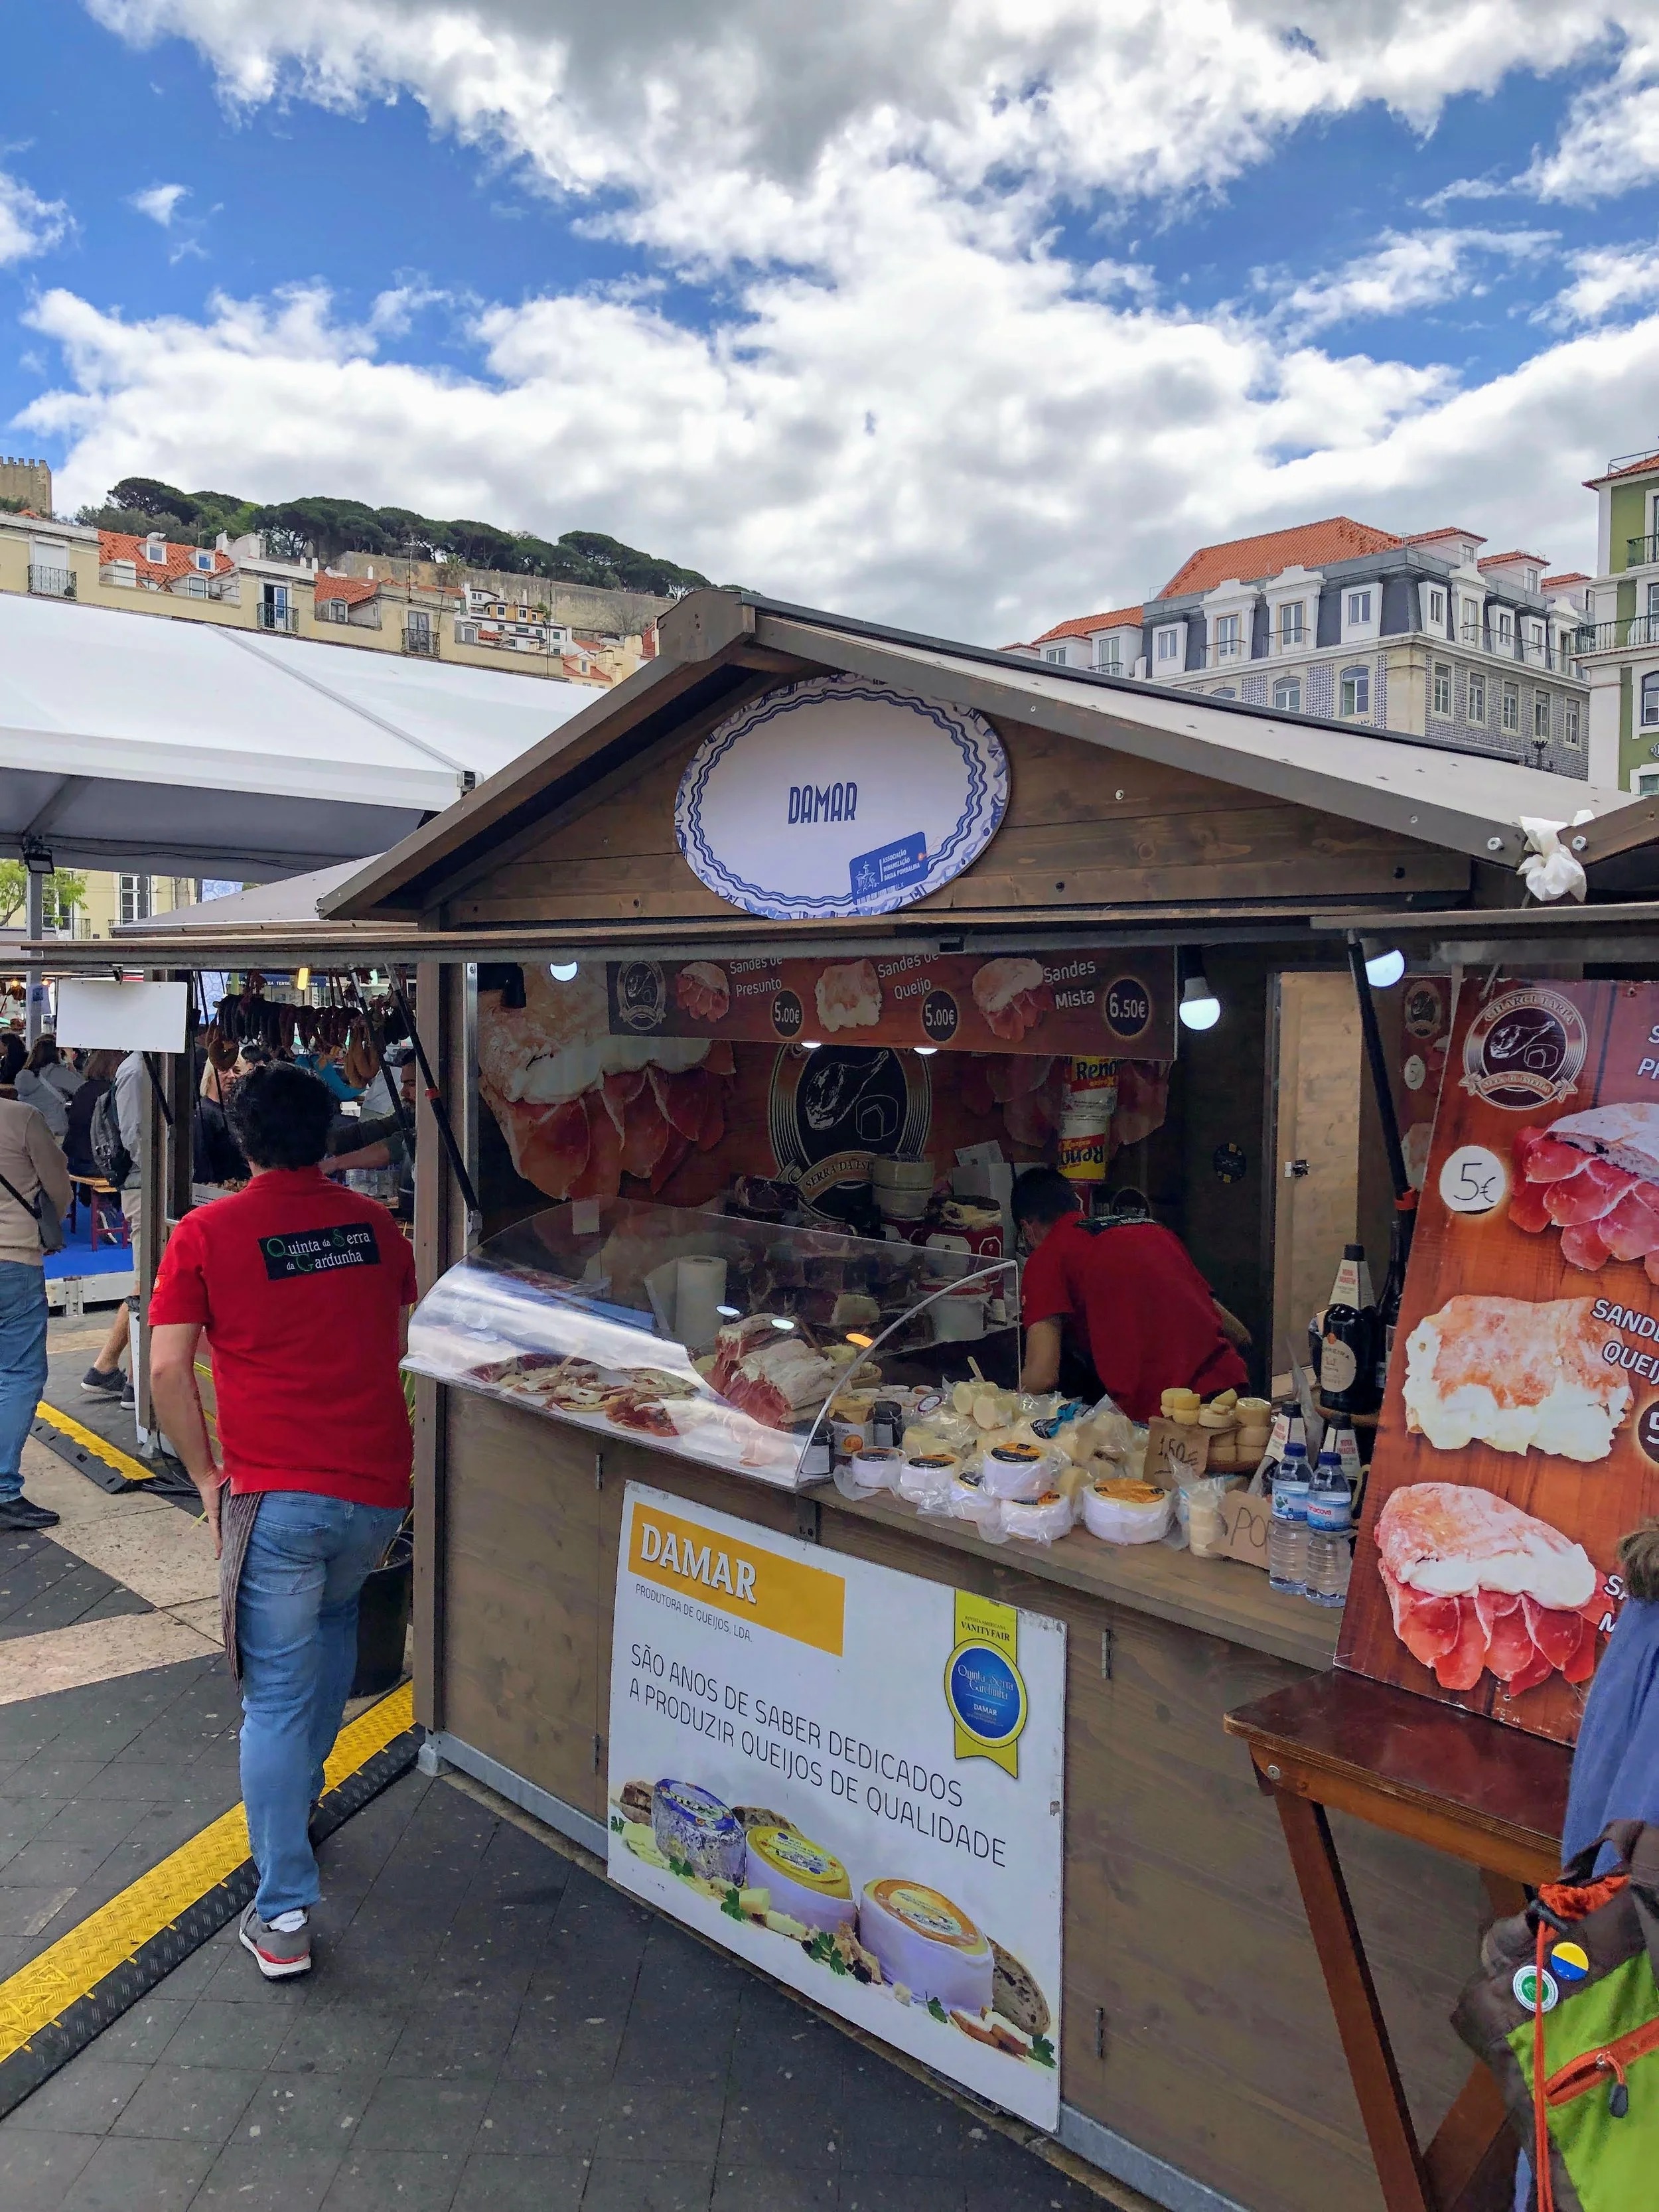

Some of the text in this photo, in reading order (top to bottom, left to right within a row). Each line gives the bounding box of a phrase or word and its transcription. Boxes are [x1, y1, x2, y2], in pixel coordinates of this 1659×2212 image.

[788, 782, 857, 824] DAMAR
[730, 957, 767, 974] Sandes
[877, 954, 921, 978] Sandes
[1043, 960, 1096, 985] Sandes
[736, 978, 782, 997] Presunto
[894, 977, 931, 999] Queijo
[1054, 989, 1095, 1010] Mista
[774, 1001, 800, 1024] 5.00€
[924, 1003, 956, 1027] 5.00€
[1109, 992, 1146, 1019] 6.50€
[805, 1165, 837, 1189] SERRA
[839, 1160, 853, 1171] DA
[1453, 1161, 1497, 1203] 5€
[267, 1228, 371, 1258] Quinta da Serra
[286, 1250, 364, 1272] da Gardunha
[640, 1522, 757, 1604] DAMAR
[636, 1583, 682, 1612] PRODUTORA
[684, 1603, 694, 1618] DE
[734, 1624, 753, 1643] LDA.
[973, 1703, 997, 1716] DAMAR
[631, 1644, 963, 1807] SÃO ANOS DE SABER DEDICADOS
[629, 1678, 640, 1702] A
[645, 1684, 735, 1747] PRODUZIR
[741, 1730, 823, 1787] QUEIJOS
[831, 1769, 859, 1804] DE
[867, 1787, 1006, 1868] QUALIDADE
